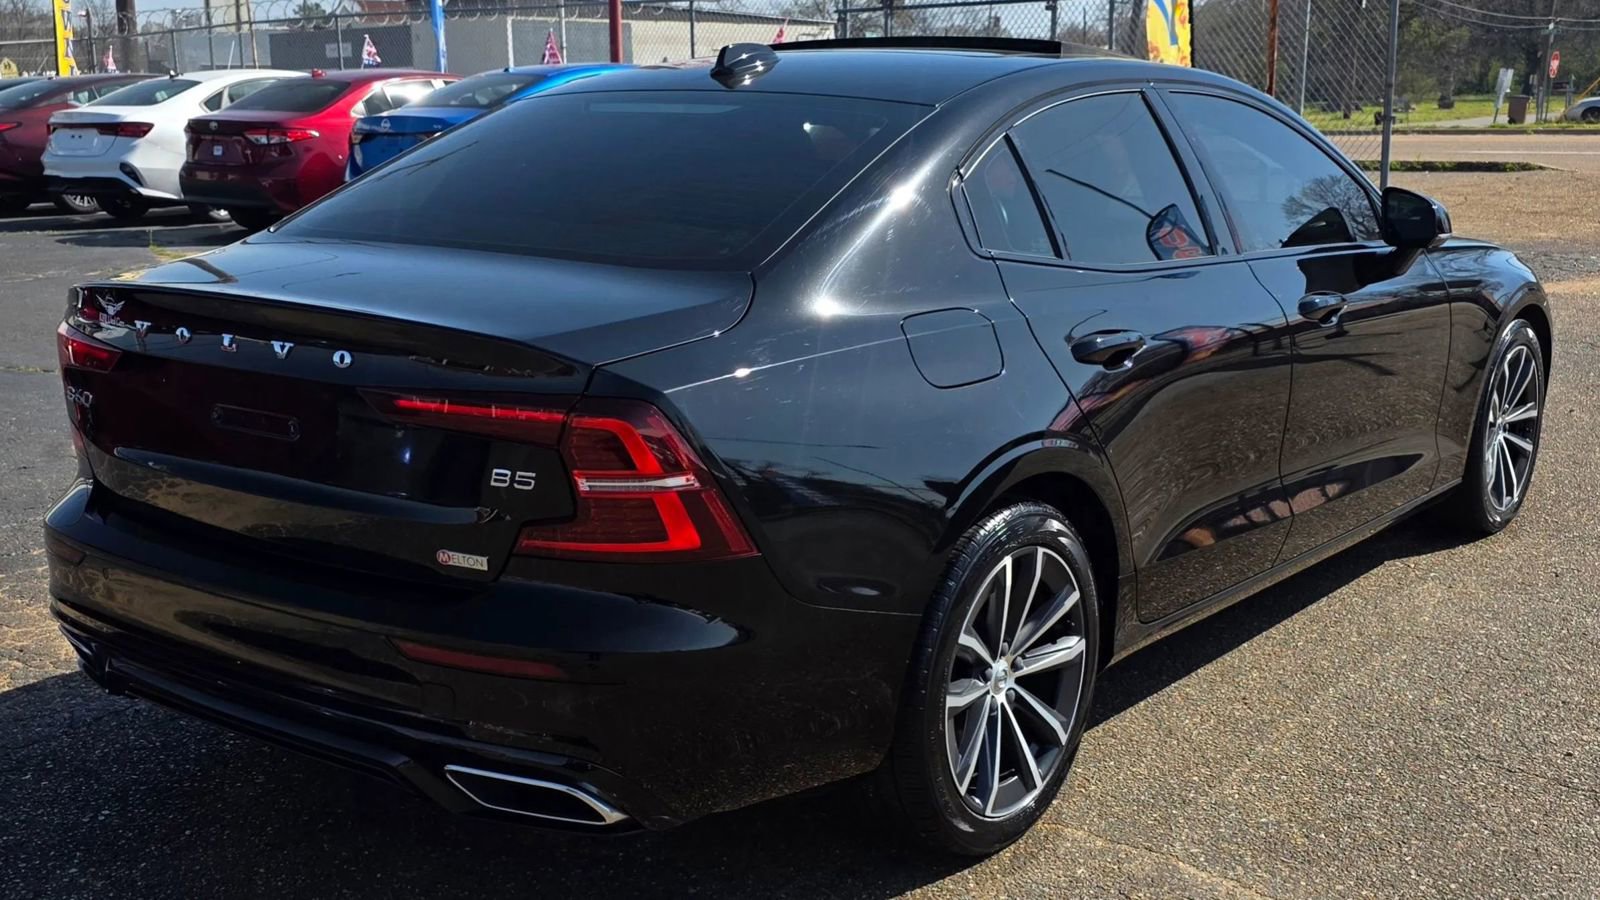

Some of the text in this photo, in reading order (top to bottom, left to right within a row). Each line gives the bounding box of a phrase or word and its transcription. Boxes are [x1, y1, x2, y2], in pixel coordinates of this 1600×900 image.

[134, 320, 353, 369] VOLVO
[490, 468, 536, 490] B5
[437, 551, 485, 568] MELTON
